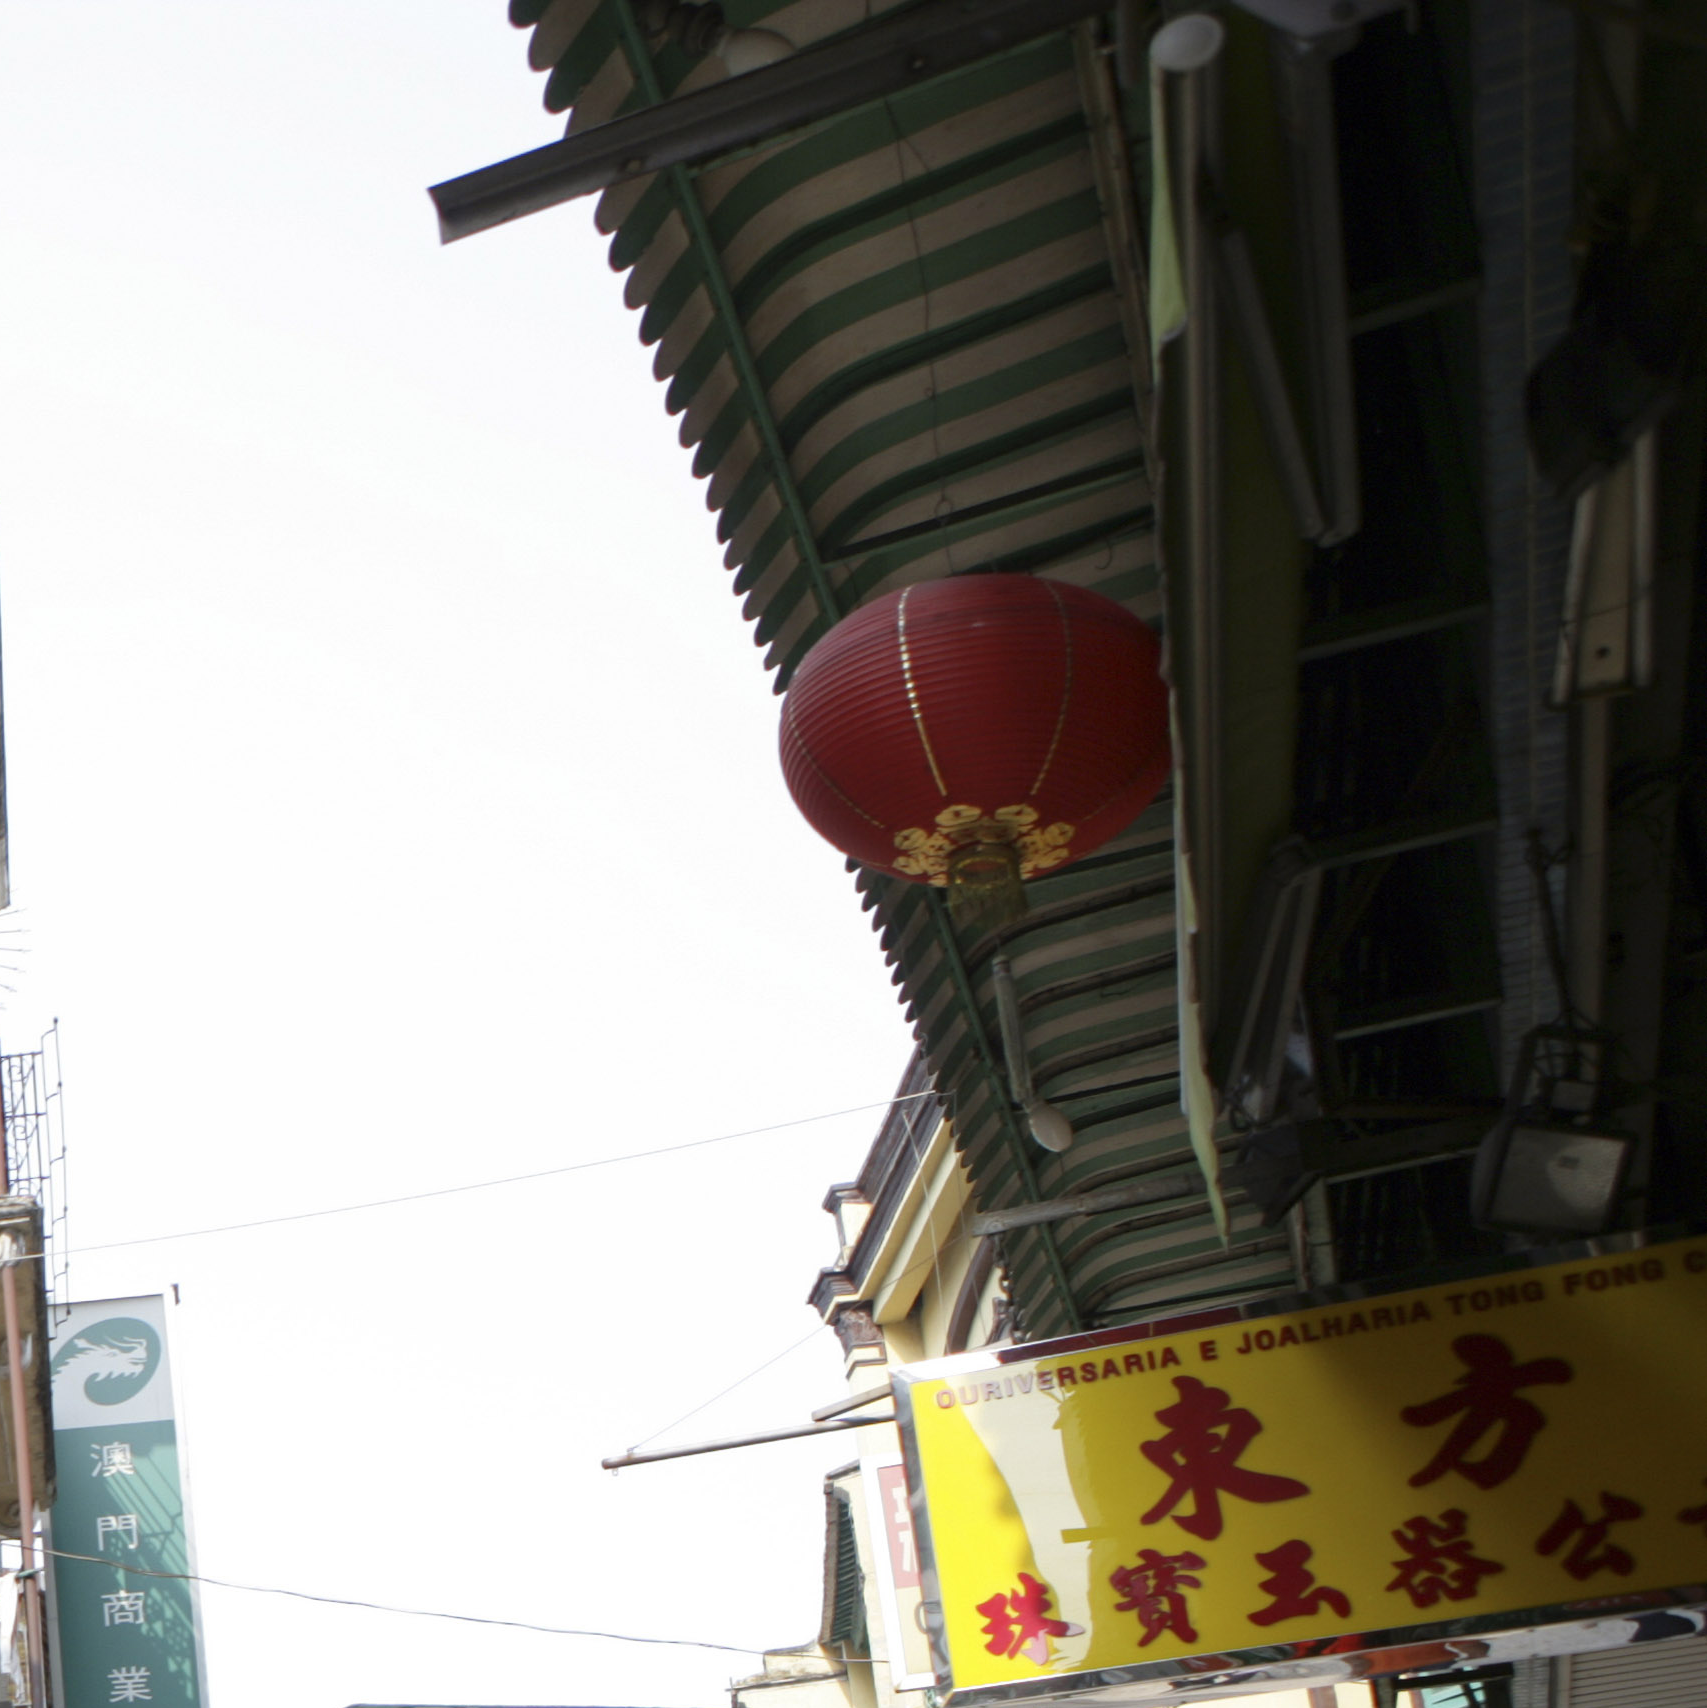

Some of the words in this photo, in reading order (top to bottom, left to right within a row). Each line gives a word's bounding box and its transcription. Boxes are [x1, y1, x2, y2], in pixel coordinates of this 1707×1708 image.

[935, 1346, 1181, 1411] OURIVERSARIA
[1200, 1340, 1219, 1361] E
[1236, 1299, 1433, 1357] JOALHARIA
[1447, 1280, 1546, 1317] TONG
[1562, 1257, 1665, 1297] FONG
[1139, 1332, 1577, 1542] 東方
[89, 1441, 153, 1704] 澳門商業
